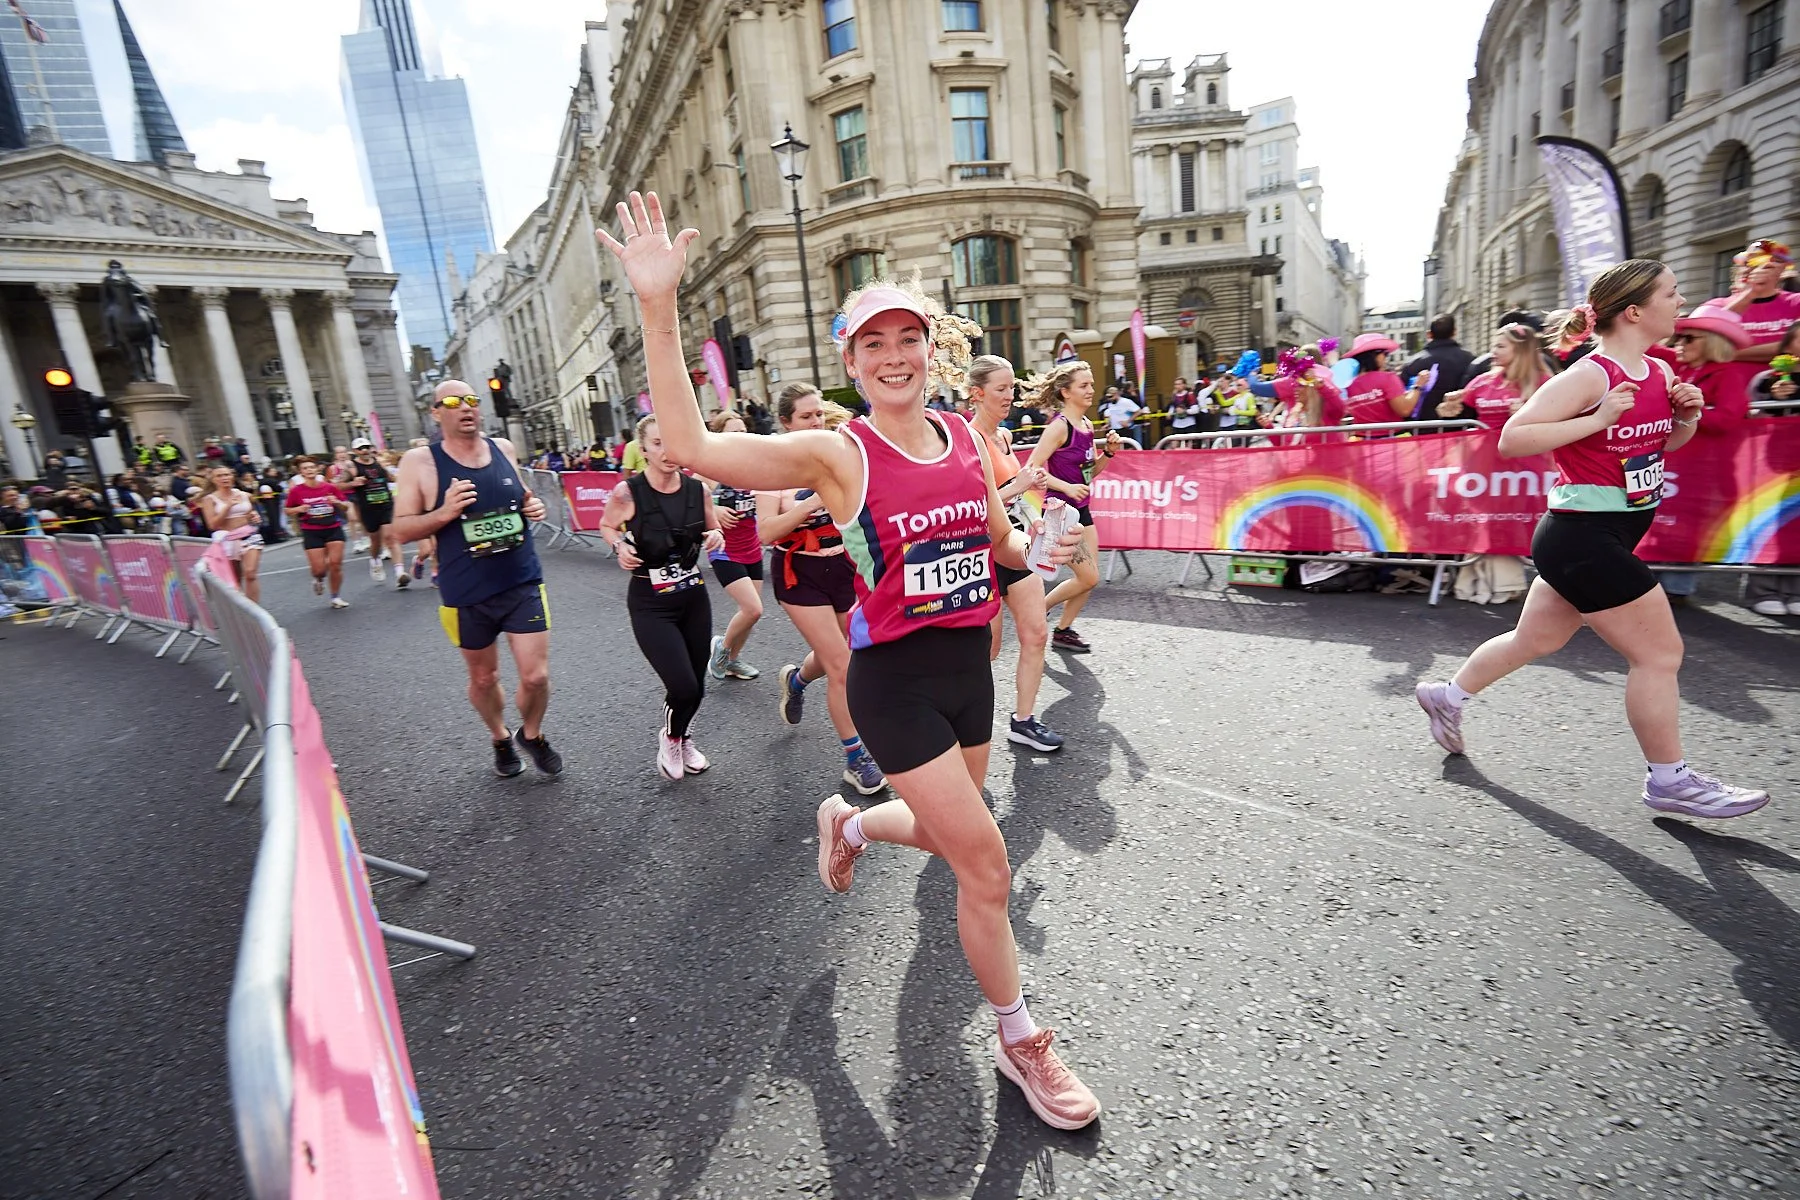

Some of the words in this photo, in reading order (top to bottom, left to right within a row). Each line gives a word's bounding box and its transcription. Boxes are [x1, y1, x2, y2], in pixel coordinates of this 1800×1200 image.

[1089, 475, 1200, 507] mmy's
[473, 518, 515, 537] 5993
[940, 540, 965, 552] PARIS
[913, 552, 984, 591] 11565
